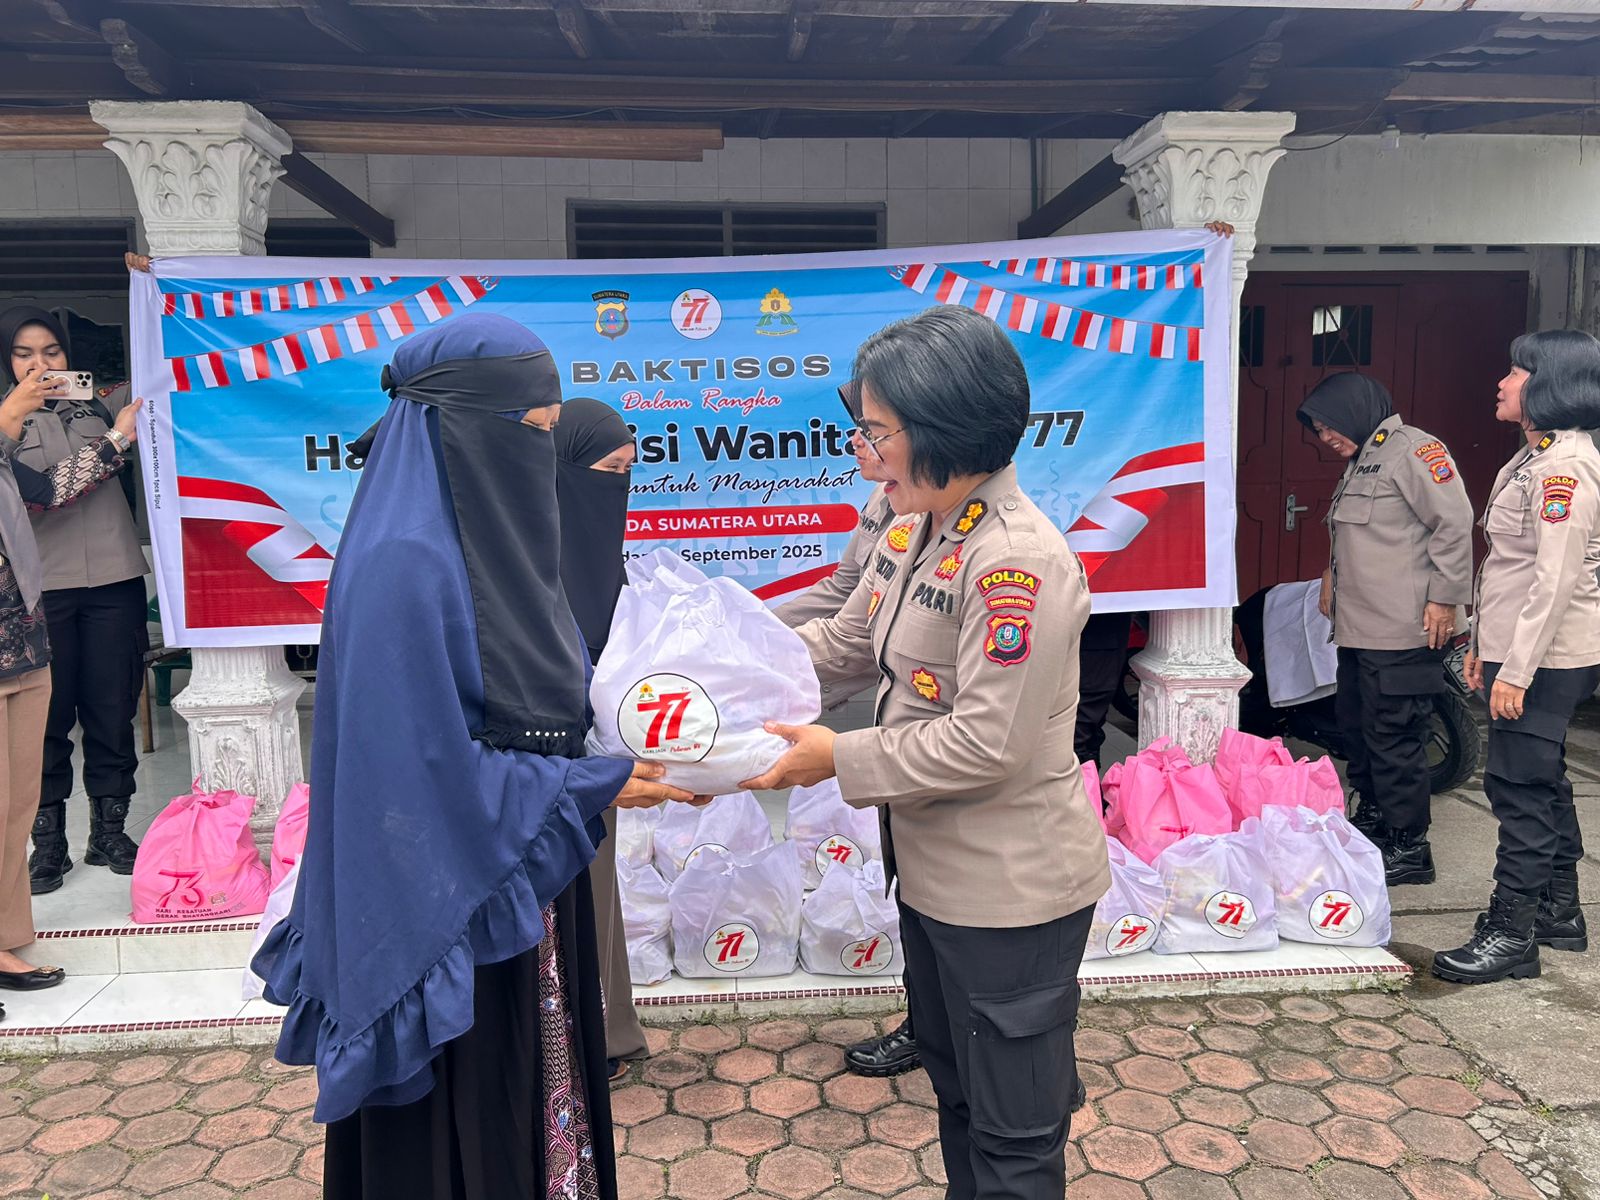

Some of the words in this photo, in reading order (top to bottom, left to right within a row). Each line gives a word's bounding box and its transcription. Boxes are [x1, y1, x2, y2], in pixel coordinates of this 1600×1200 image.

[681, 297, 710, 327] 77
[572, 355, 831, 383] BAKTISOS
[621, 389, 692, 411] Dalam
[702, 388, 782, 416] Rangka
[305, 435, 364, 470] Ha
[626, 423, 679, 463] isi
[1026, 410, 1084, 447] 77
[1417, 442, 1441, 456] POLDA
[628, 472, 700, 494] untuk
[708, 467, 861, 503] Masyarakat
[1544, 477, 1575, 486] POLDA
[658, 514, 757, 531] SUMATERA
[762, 512, 822, 528] UTARA
[681, 546, 777, 564] September
[782, 544, 822, 558] 2025
[981, 570, 1035, 589] POLDA
[637, 691, 692, 748] 77
[156, 871, 206, 908] 73
[1217, 901, 1245, 925] 77
[1319, 901, 1352, 927] 77
[715, 930, 746, 962] 77
[1115, 925, 1149, 948] 77
